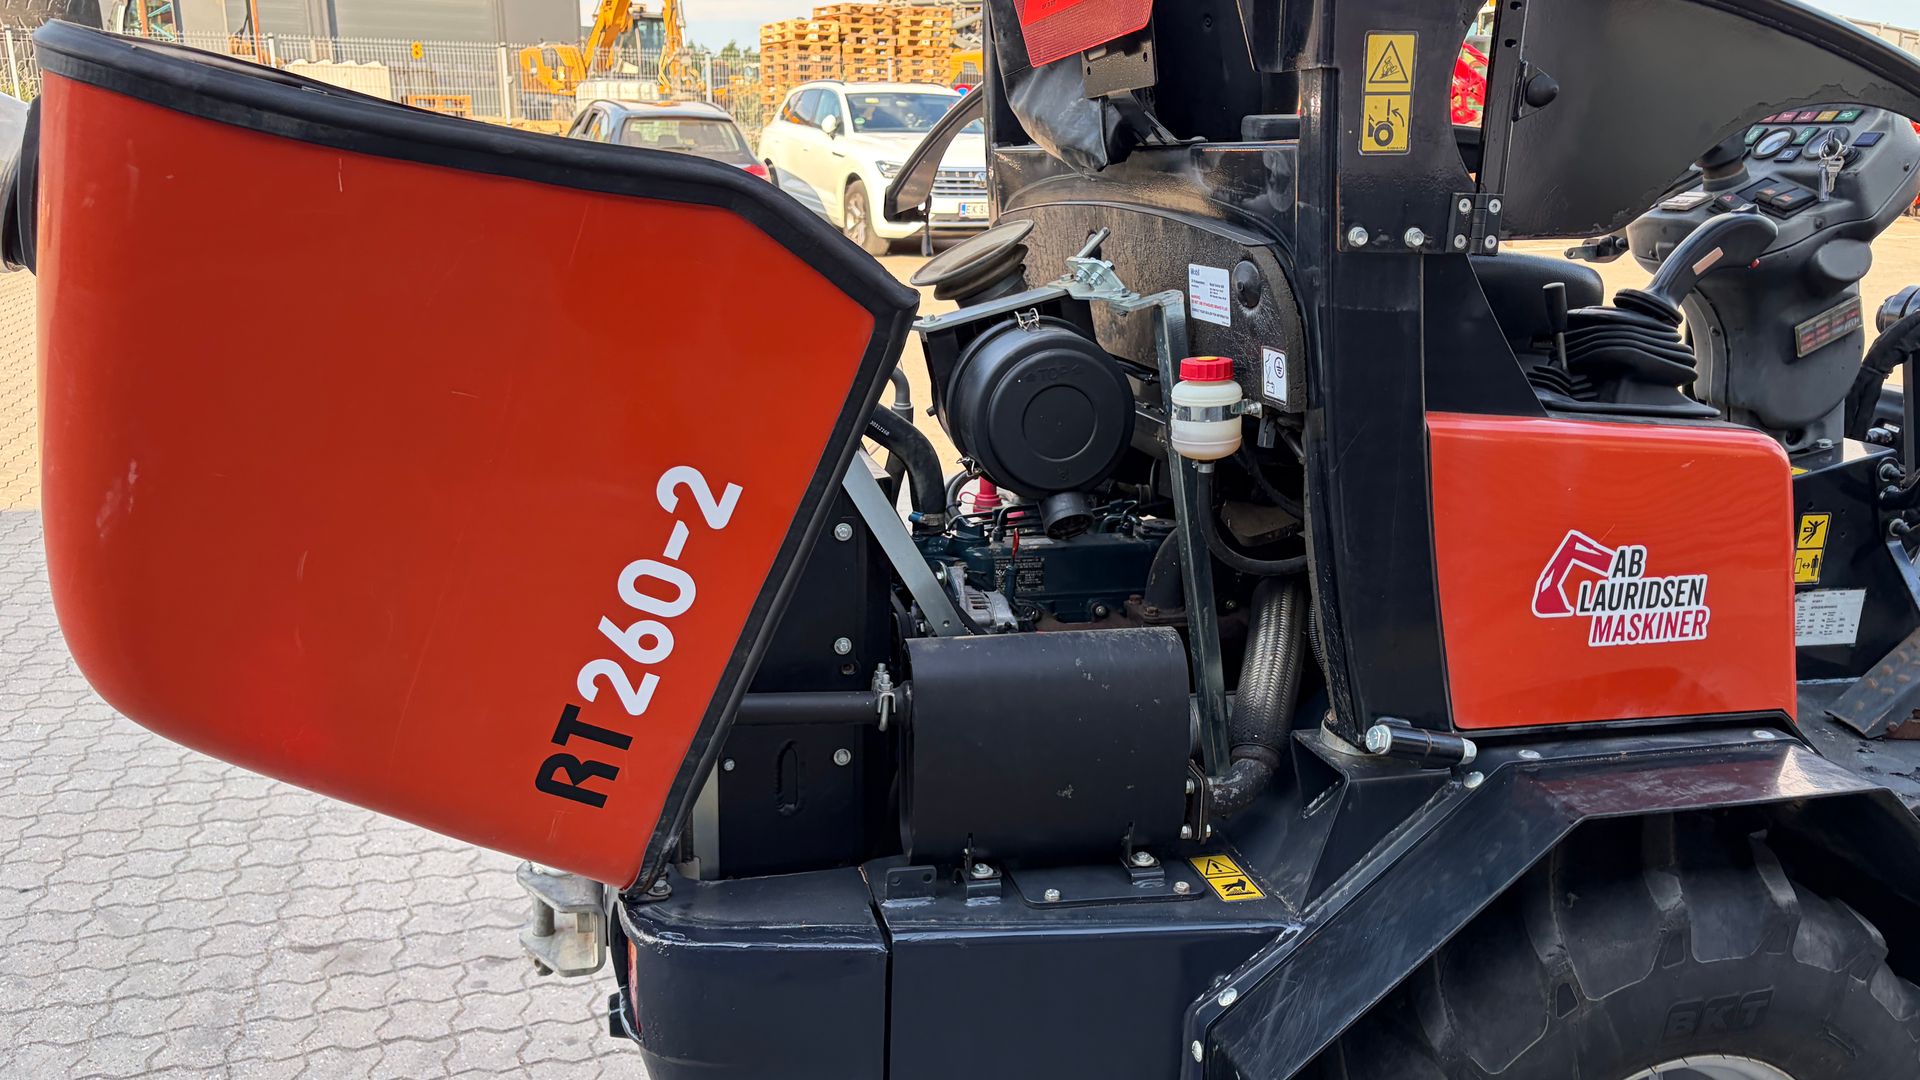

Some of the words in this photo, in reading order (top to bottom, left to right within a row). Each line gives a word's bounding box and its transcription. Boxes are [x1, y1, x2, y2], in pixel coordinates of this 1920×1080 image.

[1612, 549, 1644, 579] AB
[1579, 578, 1704, 613] LAURIDSEN
[1591, 609, 1707, 644] MASKINER
[1660, 985, 1775, 1044] BKT
